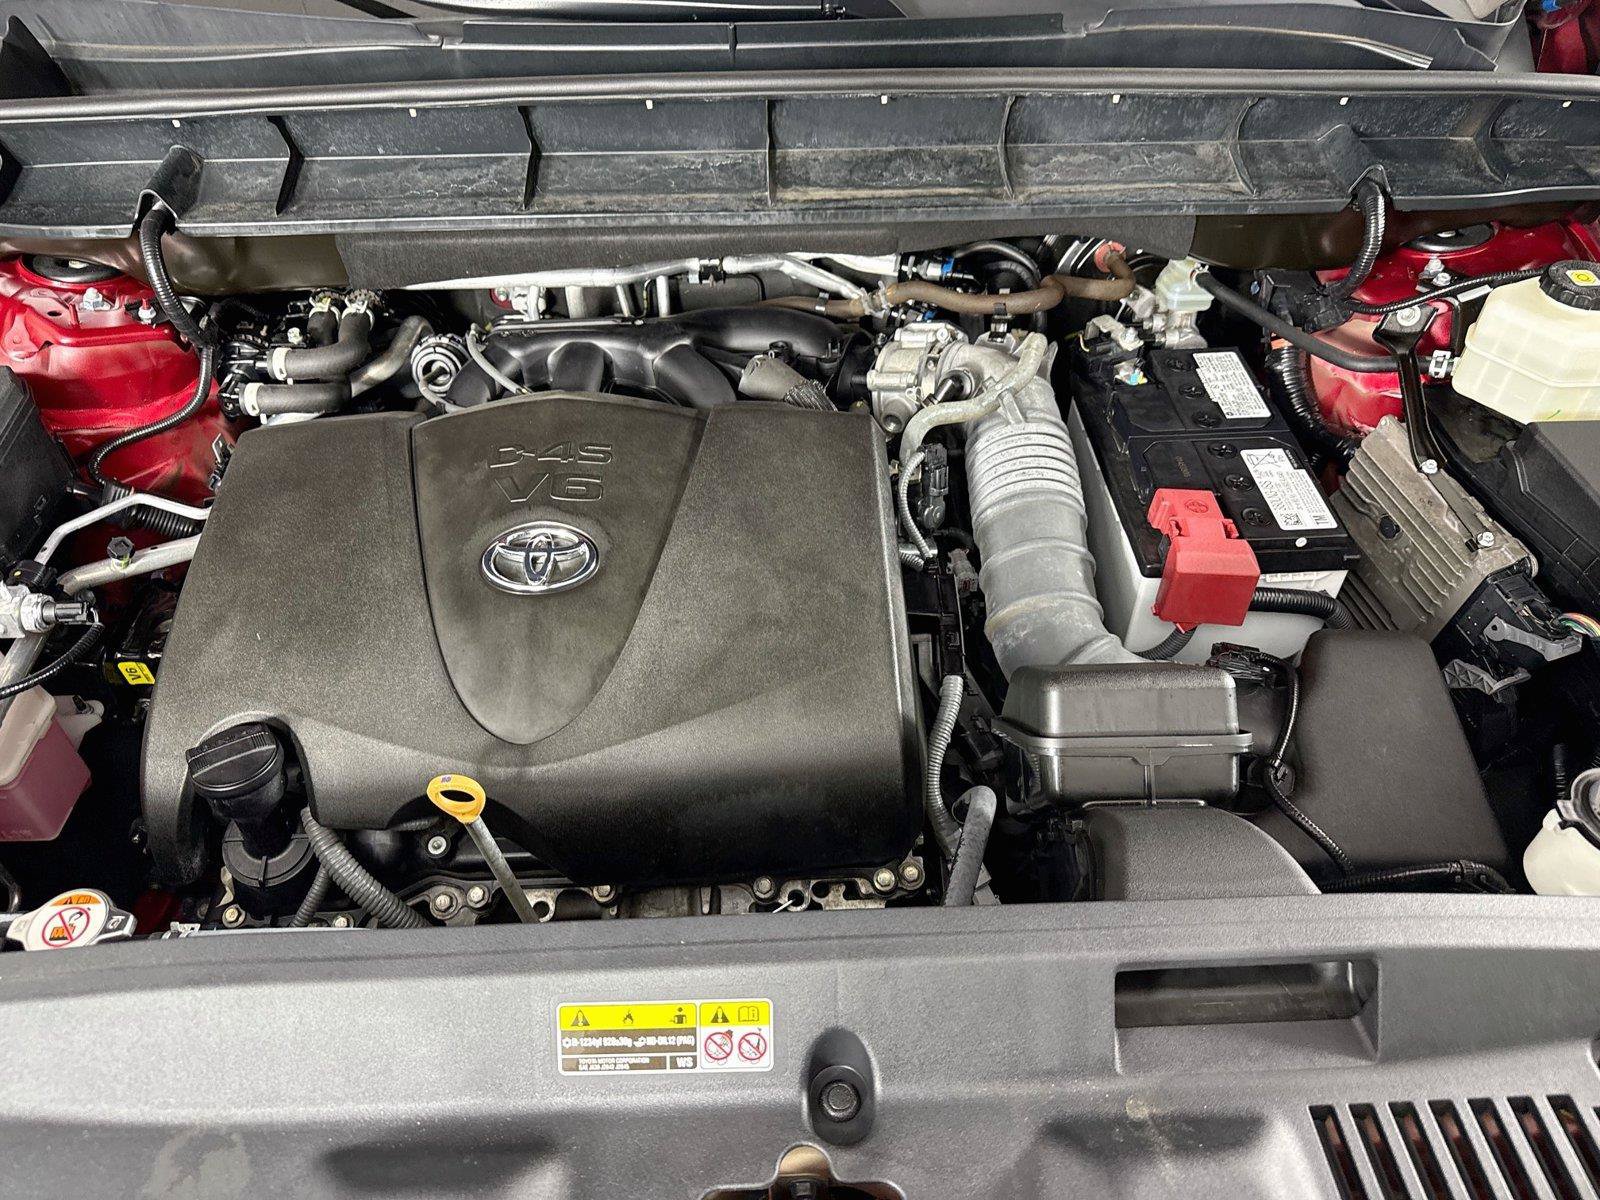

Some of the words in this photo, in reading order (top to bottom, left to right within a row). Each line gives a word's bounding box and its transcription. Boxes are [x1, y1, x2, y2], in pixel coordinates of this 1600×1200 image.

[489, 441, 613, 468] D-4S
[494, 472, 604, 503] V6
[125, 667, 142, 681] V6
[675, 1056, 694, 1068] WS
